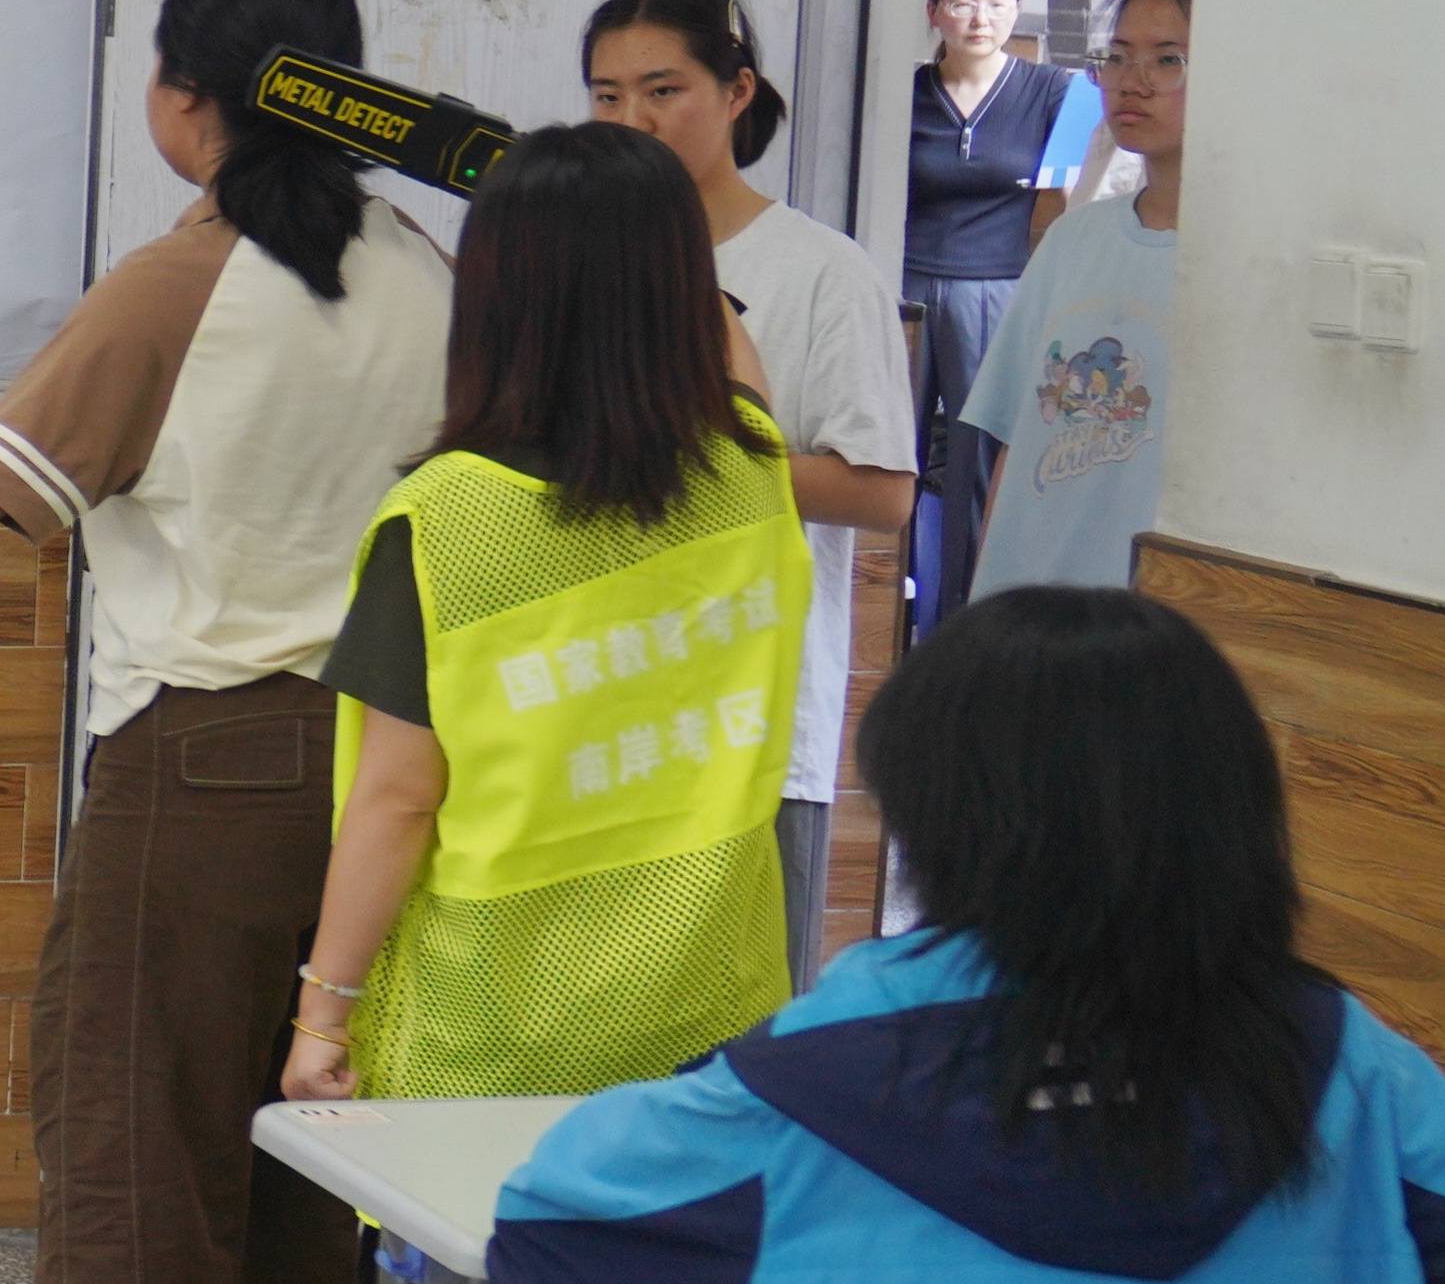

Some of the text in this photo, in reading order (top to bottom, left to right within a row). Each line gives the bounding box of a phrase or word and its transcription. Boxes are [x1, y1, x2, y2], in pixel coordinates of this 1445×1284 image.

[268, 71, 416, 145] METAL DETECT
[568, 687, 768, 802] 南岸考区
